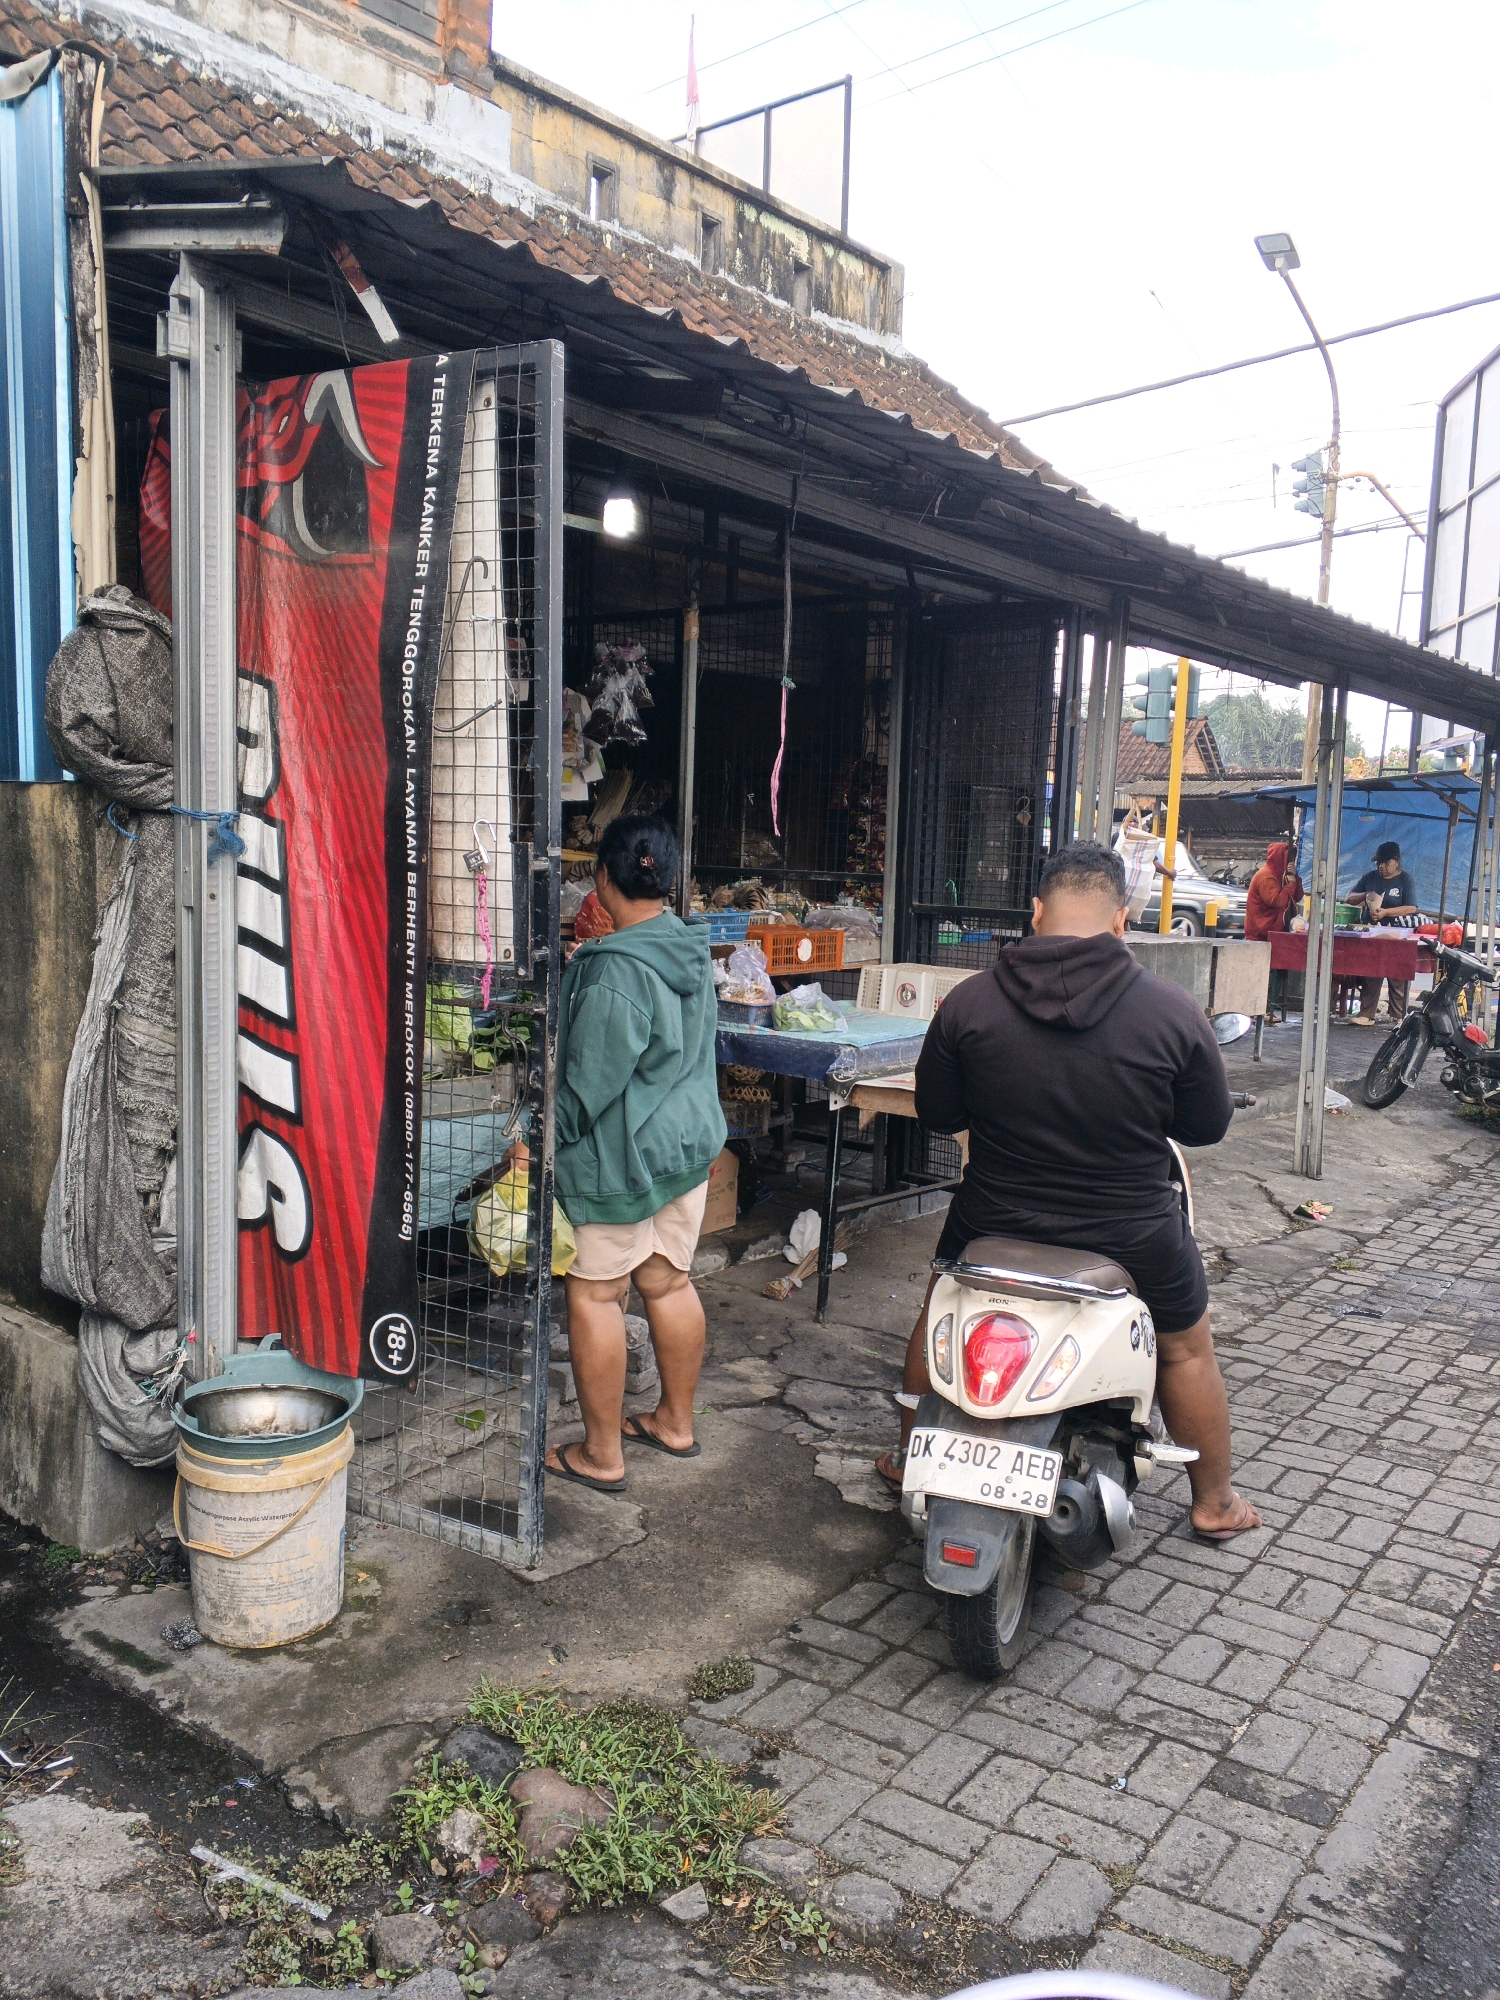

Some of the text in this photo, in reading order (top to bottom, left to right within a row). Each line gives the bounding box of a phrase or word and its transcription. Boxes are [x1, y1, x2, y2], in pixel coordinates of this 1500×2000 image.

[398, 352, 452, 1241] A TERKENA KANKER TENGGOROKAN. LAYANAN BERHENTI MEROKOK (0800-177-6565)
[988, 1297, 1016, 1305] HON
[387, 1322, 407, 1366] 18+
[910, 1434, 1057, 1481] DK 4302 AEB
